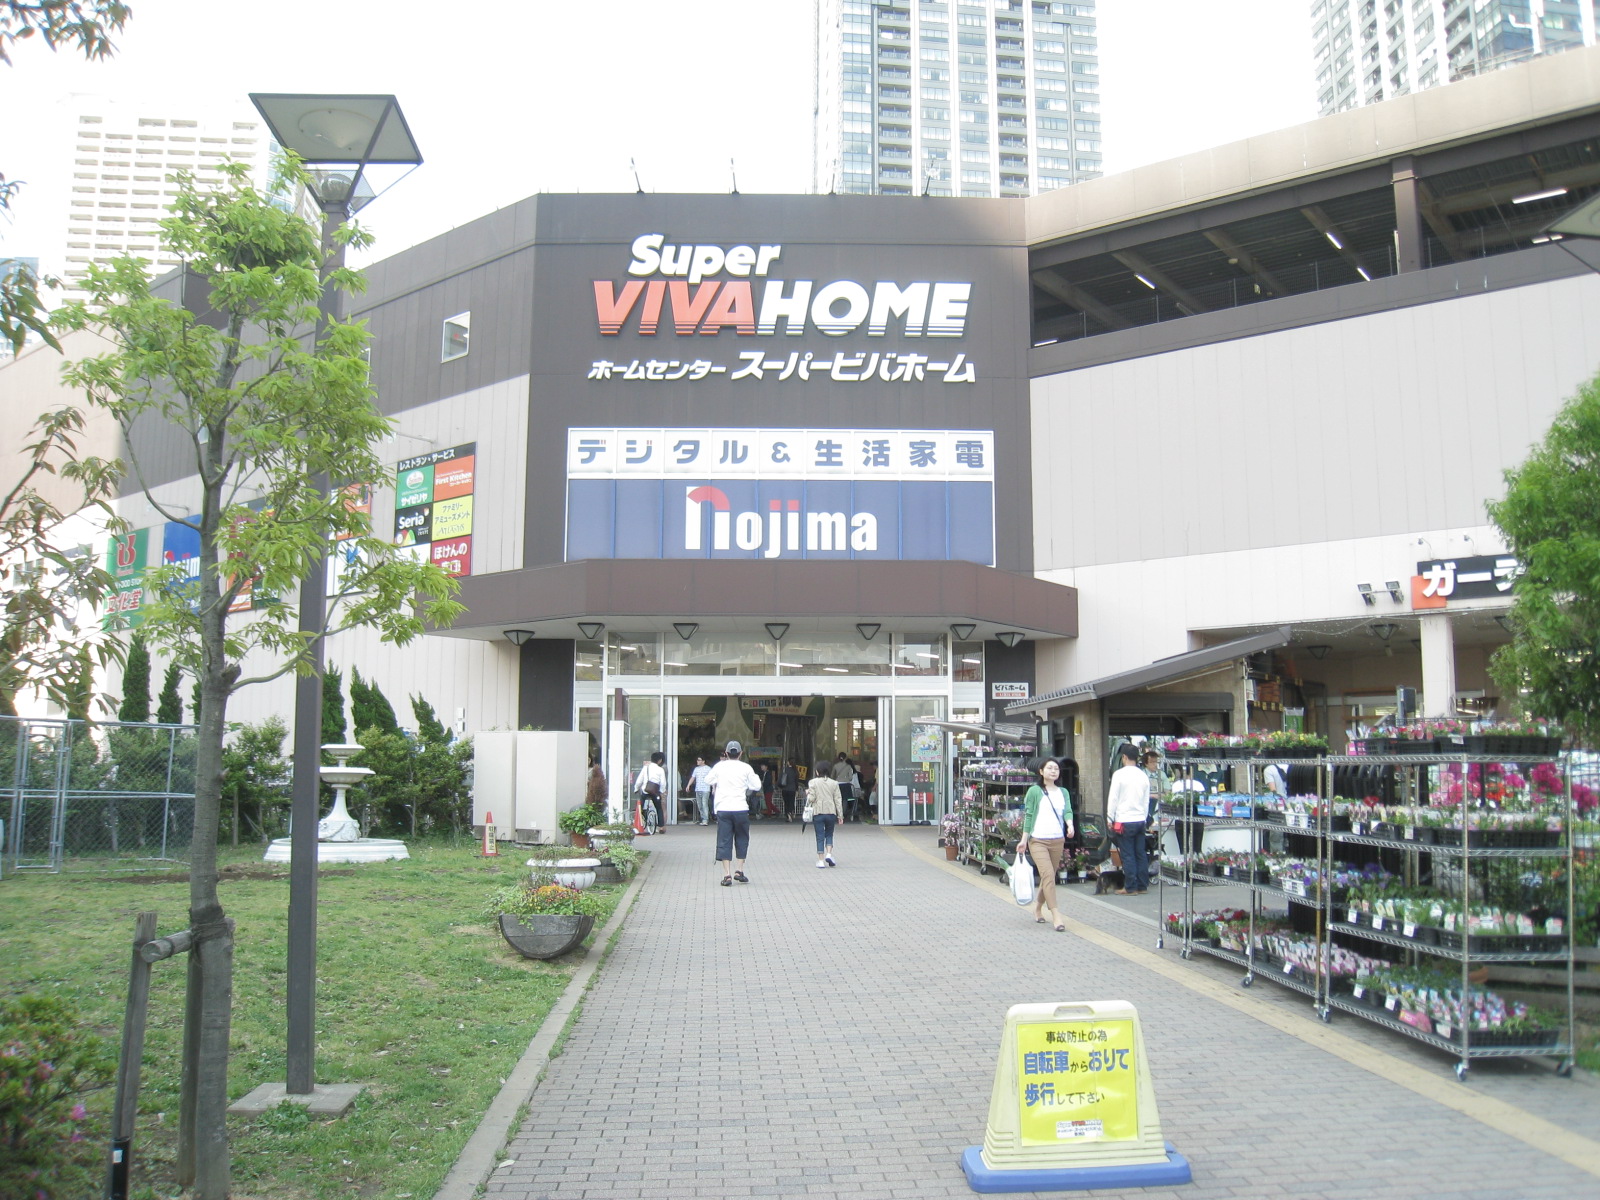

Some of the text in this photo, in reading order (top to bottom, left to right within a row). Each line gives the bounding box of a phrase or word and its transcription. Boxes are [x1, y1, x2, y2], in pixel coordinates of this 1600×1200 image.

[628, 232, 781, 283] Super
[588, 350, 977, 383] ホームセンター スーパービバホーム
[399, 449, 455, 471] レストラン・サービス
[398, 512, 425, 530] Seria
[685, 485, 878, 559] nojima
[434, 542, 468, 560] ほけんの
[1045, 1030, 1107, 1044] 事故防止の為
[1023, 1048, 1130, 1075] 自転車からおりて
[1024, 1082, 1105, 1107] 歩行して下さい
